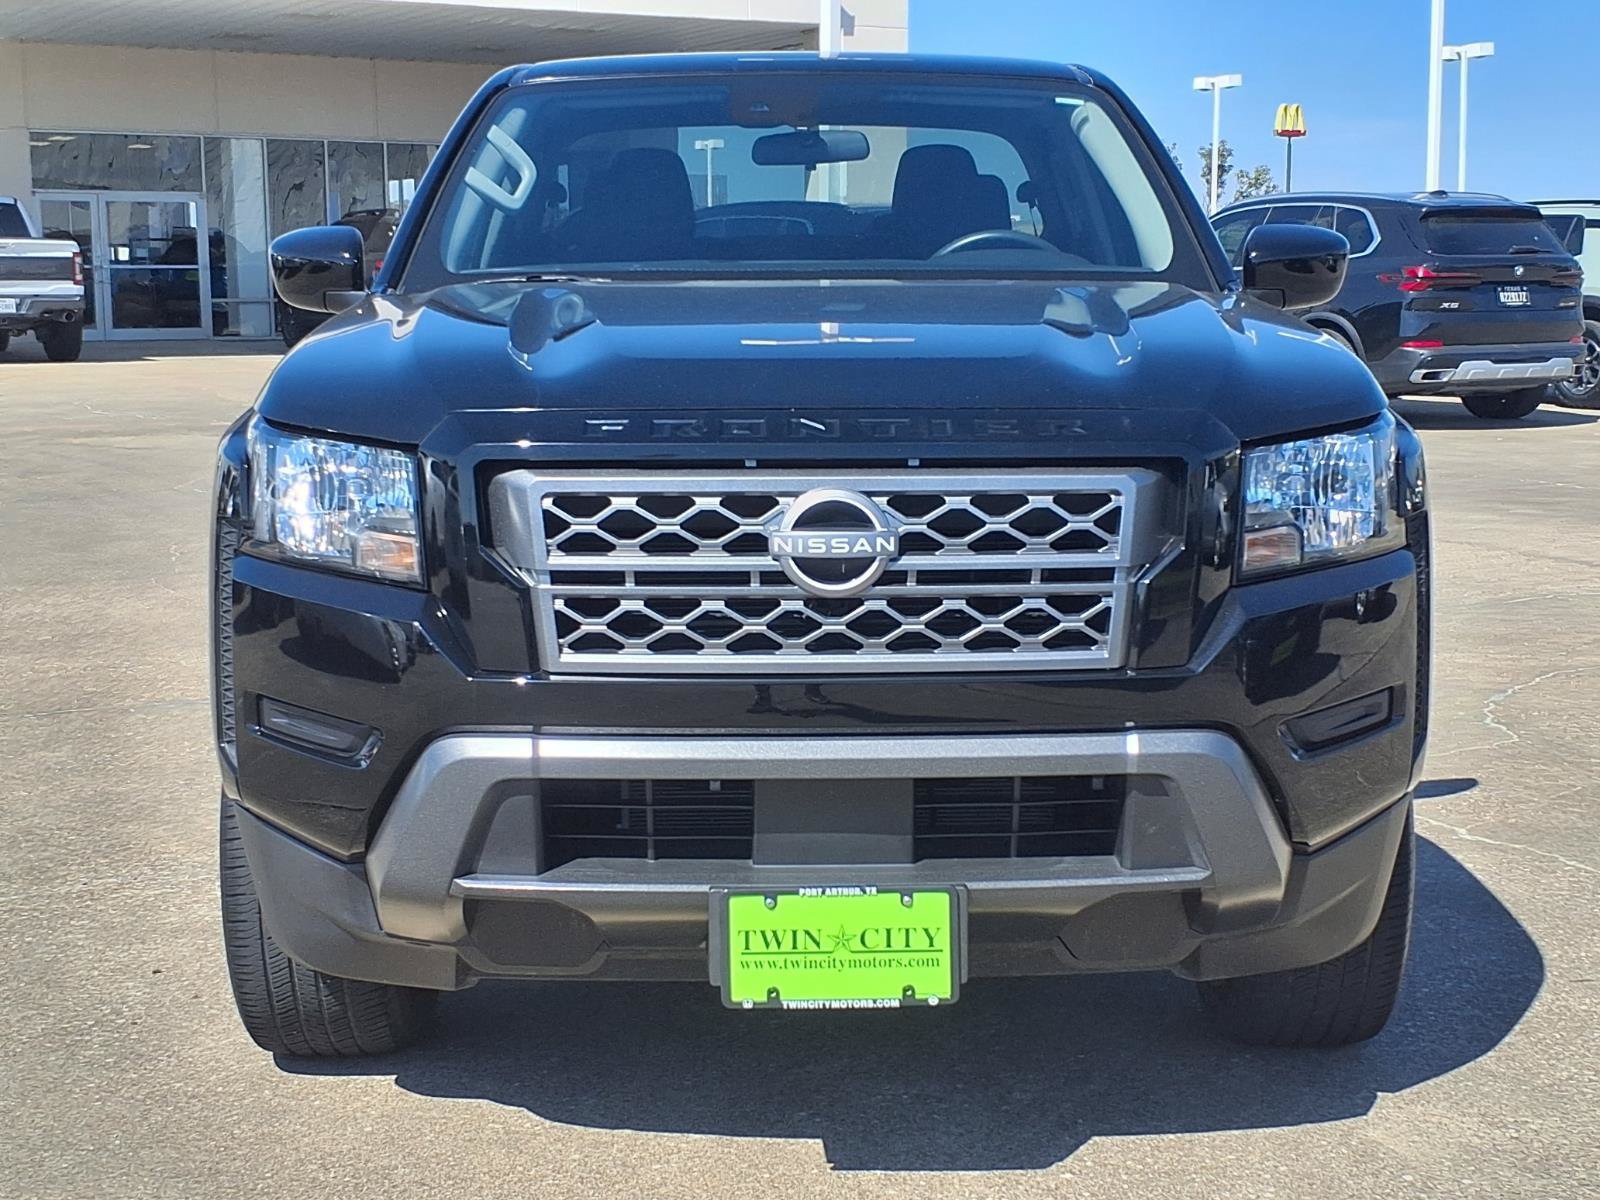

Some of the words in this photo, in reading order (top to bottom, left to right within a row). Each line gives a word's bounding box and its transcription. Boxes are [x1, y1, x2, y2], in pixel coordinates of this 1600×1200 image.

[584, 418, 1088, 438] FRONTIER
[773, 535, 897, 553] NISSAN
[799, 887, 823, 897] PORT
[865, 886, 878, 896] TX
[738, 928, 821, 951] TWIN
[860, 927, 941, 949] CITY
[740, 955, 940, 972] www.twincitymotors.com
[781, 999, 901, 1010] TWINCITYMOTORS.COM
